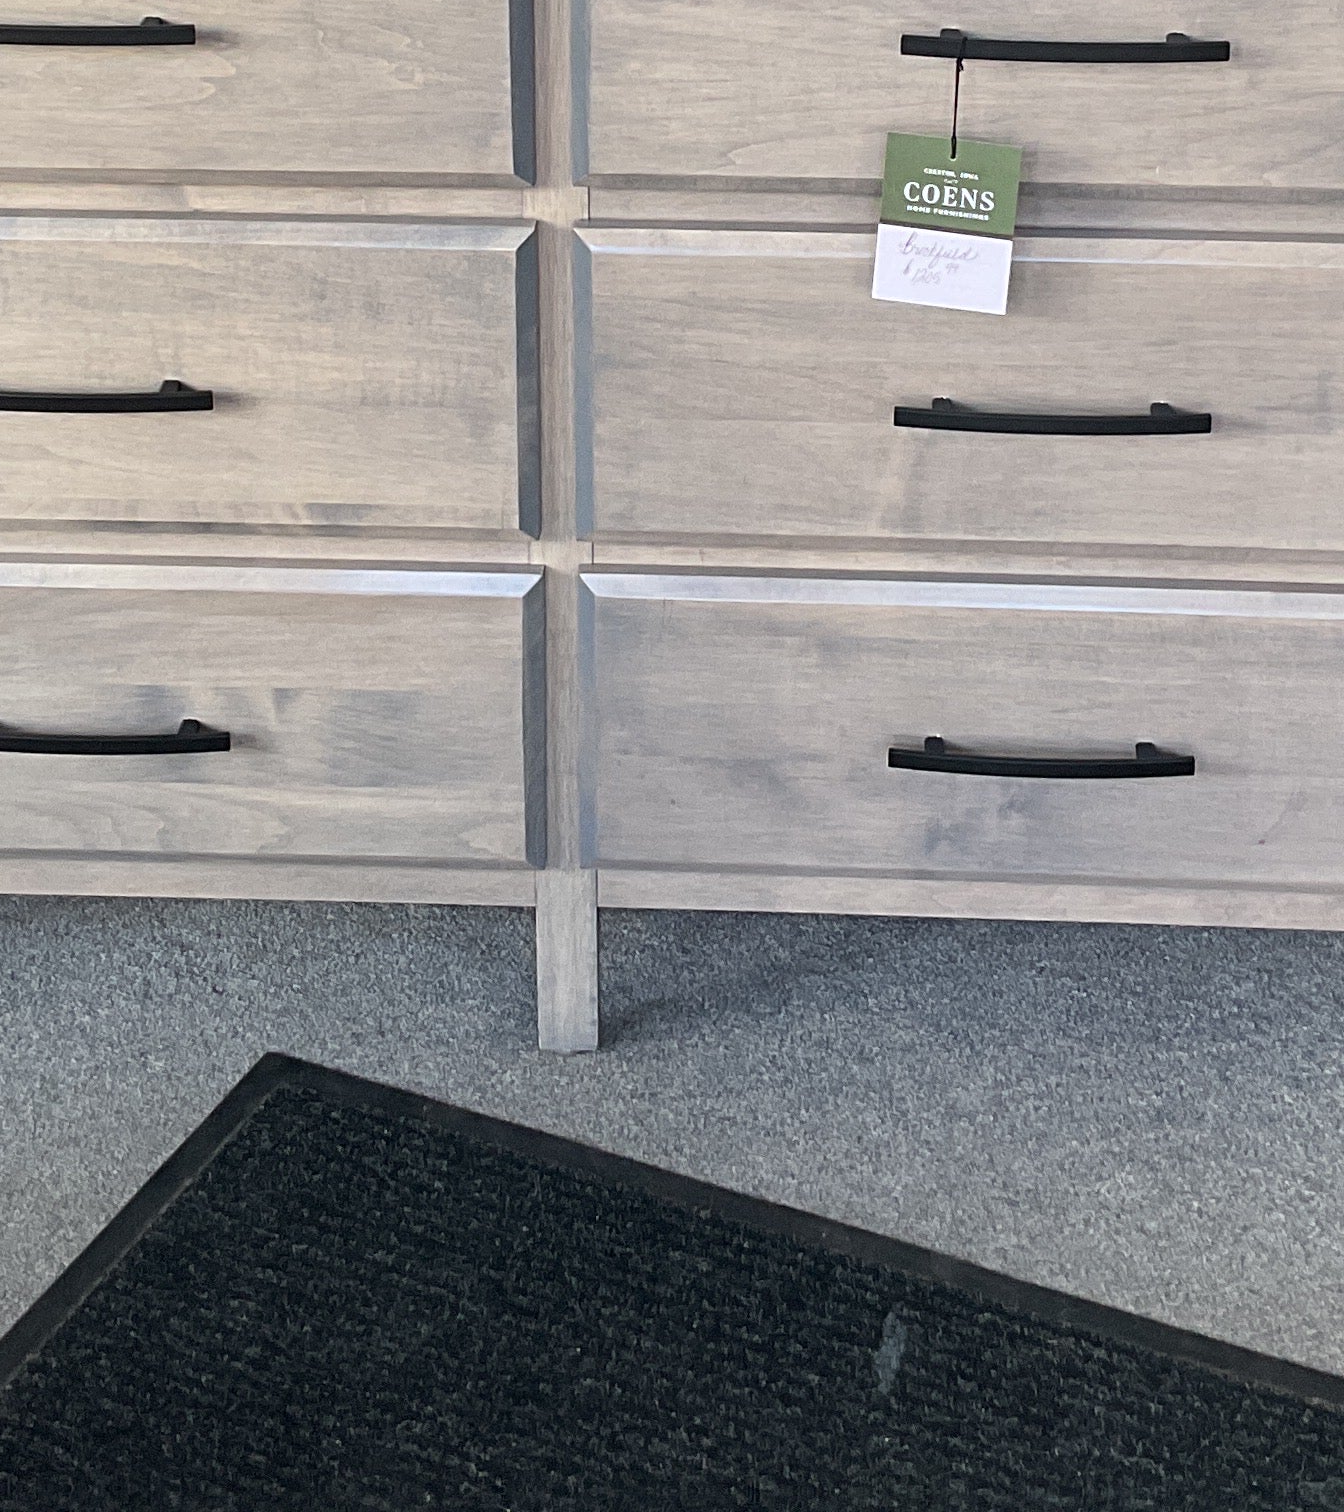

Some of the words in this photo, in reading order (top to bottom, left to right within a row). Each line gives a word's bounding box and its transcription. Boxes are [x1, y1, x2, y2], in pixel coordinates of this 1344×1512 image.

[903, 181, 995, 211] COENS
[906, 204, 931, 214] HOME
[933, 207, 989, 221] FURNISHINGS
